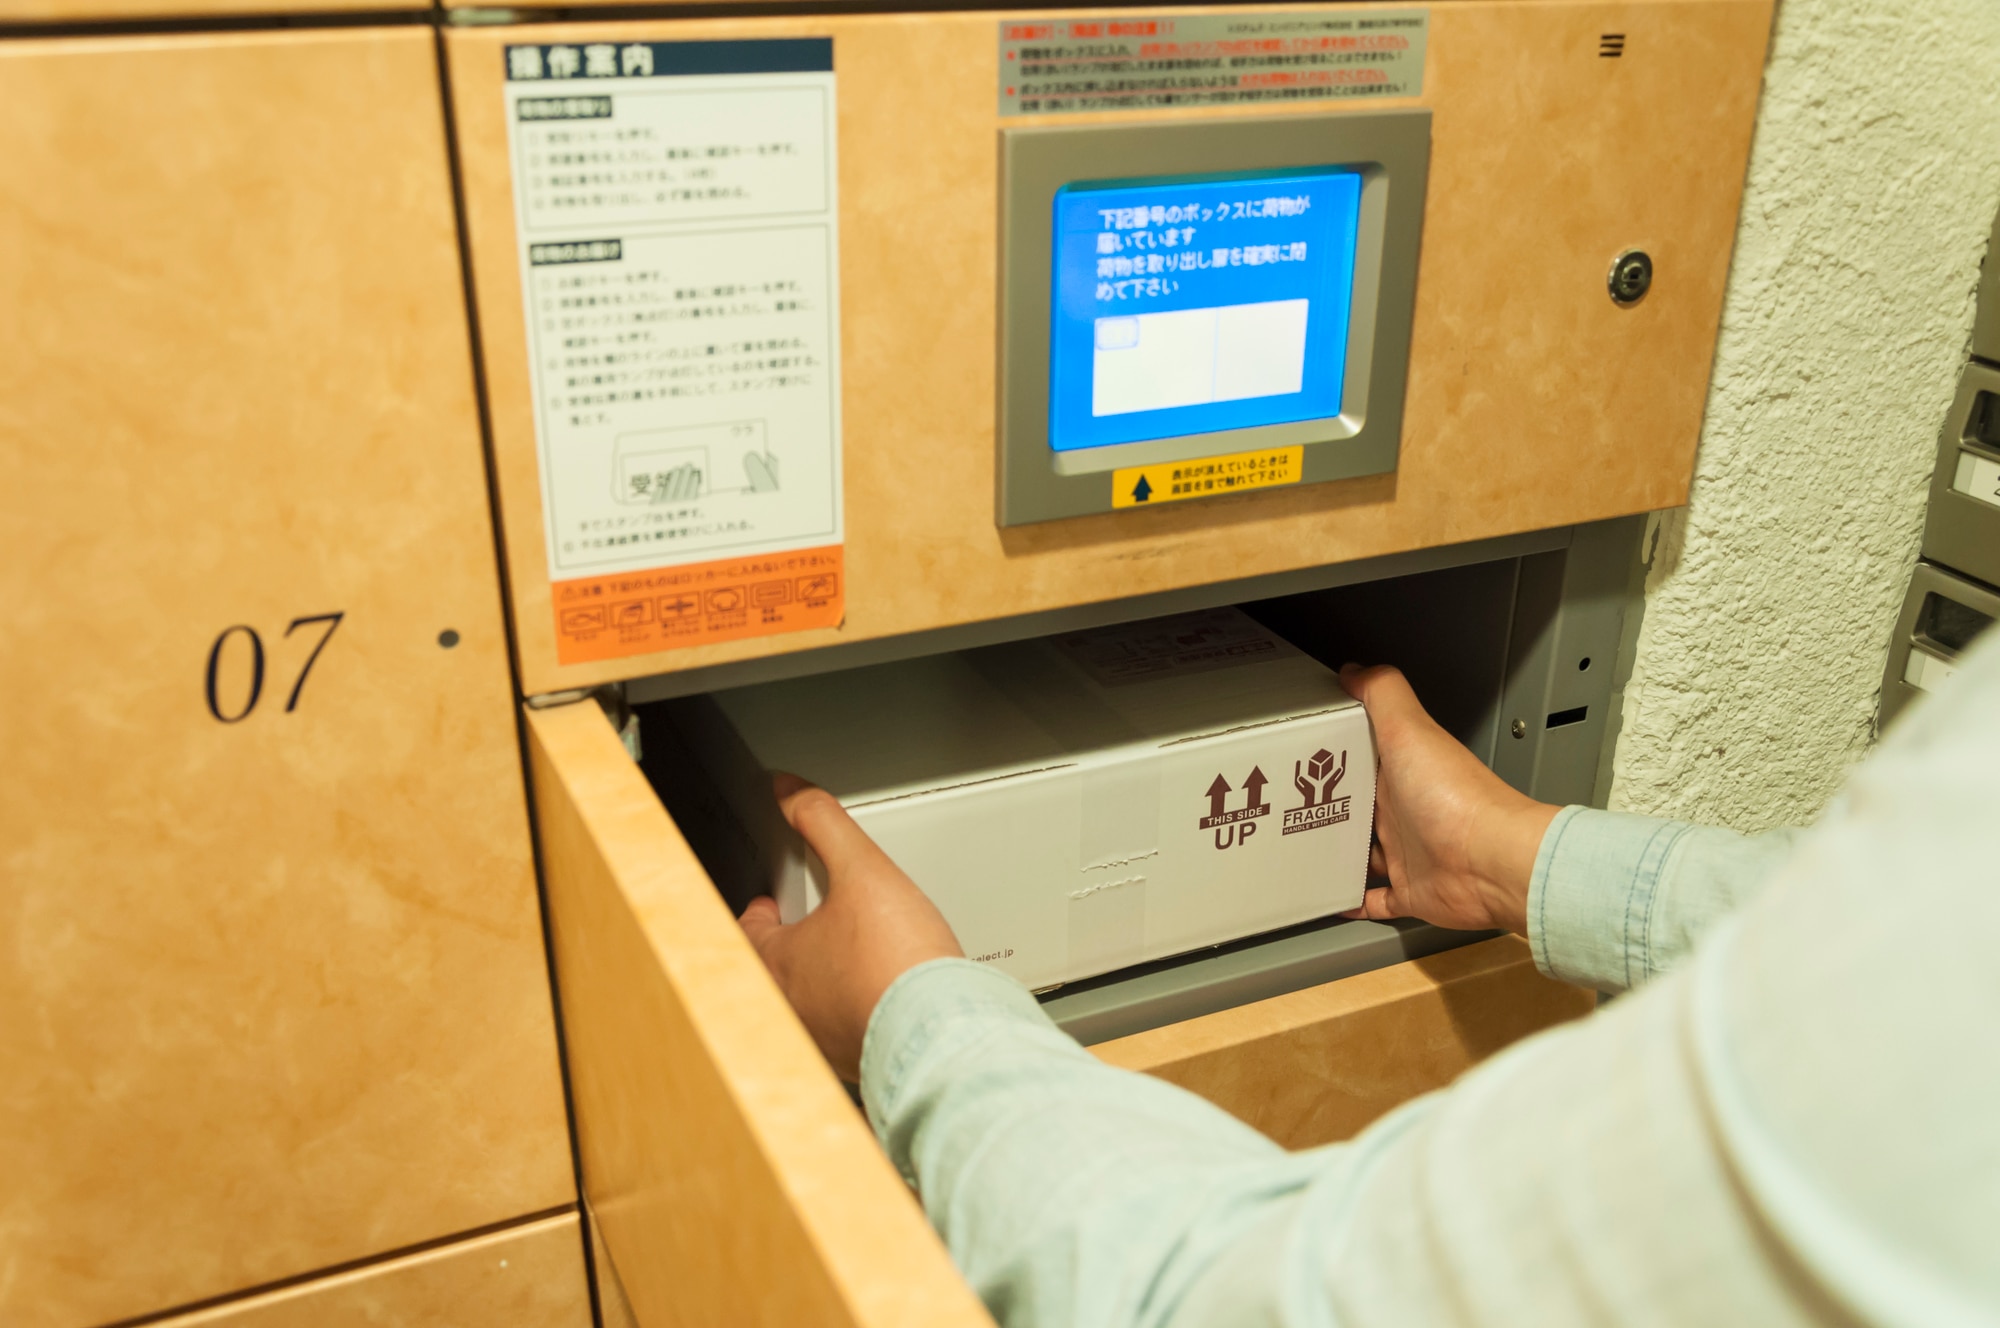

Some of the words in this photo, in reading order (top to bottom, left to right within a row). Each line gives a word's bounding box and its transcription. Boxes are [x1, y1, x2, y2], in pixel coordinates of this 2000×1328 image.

[509, 44, 654, 79] 操作案内
[1098, 195, 1311, 230] 下記番号のボックスに荷物が
[1096, 226, 1197, 255] 届いています
[1096, 241, 1308, 279] 荷物を取り出し扉を確実に閉
[1095, 277, 1180, 301] めて下さい
[1172, 454, 1288, 481] 表示が消えているときは
[1171, 469, 1288, 495] 画面を指で触れて下さい
[204, 610, 346, 725] 07
[1207, 812, 1233, 826] THIS
[1236, 806, 1263, 820] SIDE
[1283, 799, 1350, 827] FRAGILE
[1283, 824, 1311, 835] HANDLE
[1311, 819, 1329, 828] WITH
[1329, 814, 1348, 825] CARE
[1215, 821, 1257, 850] UP
